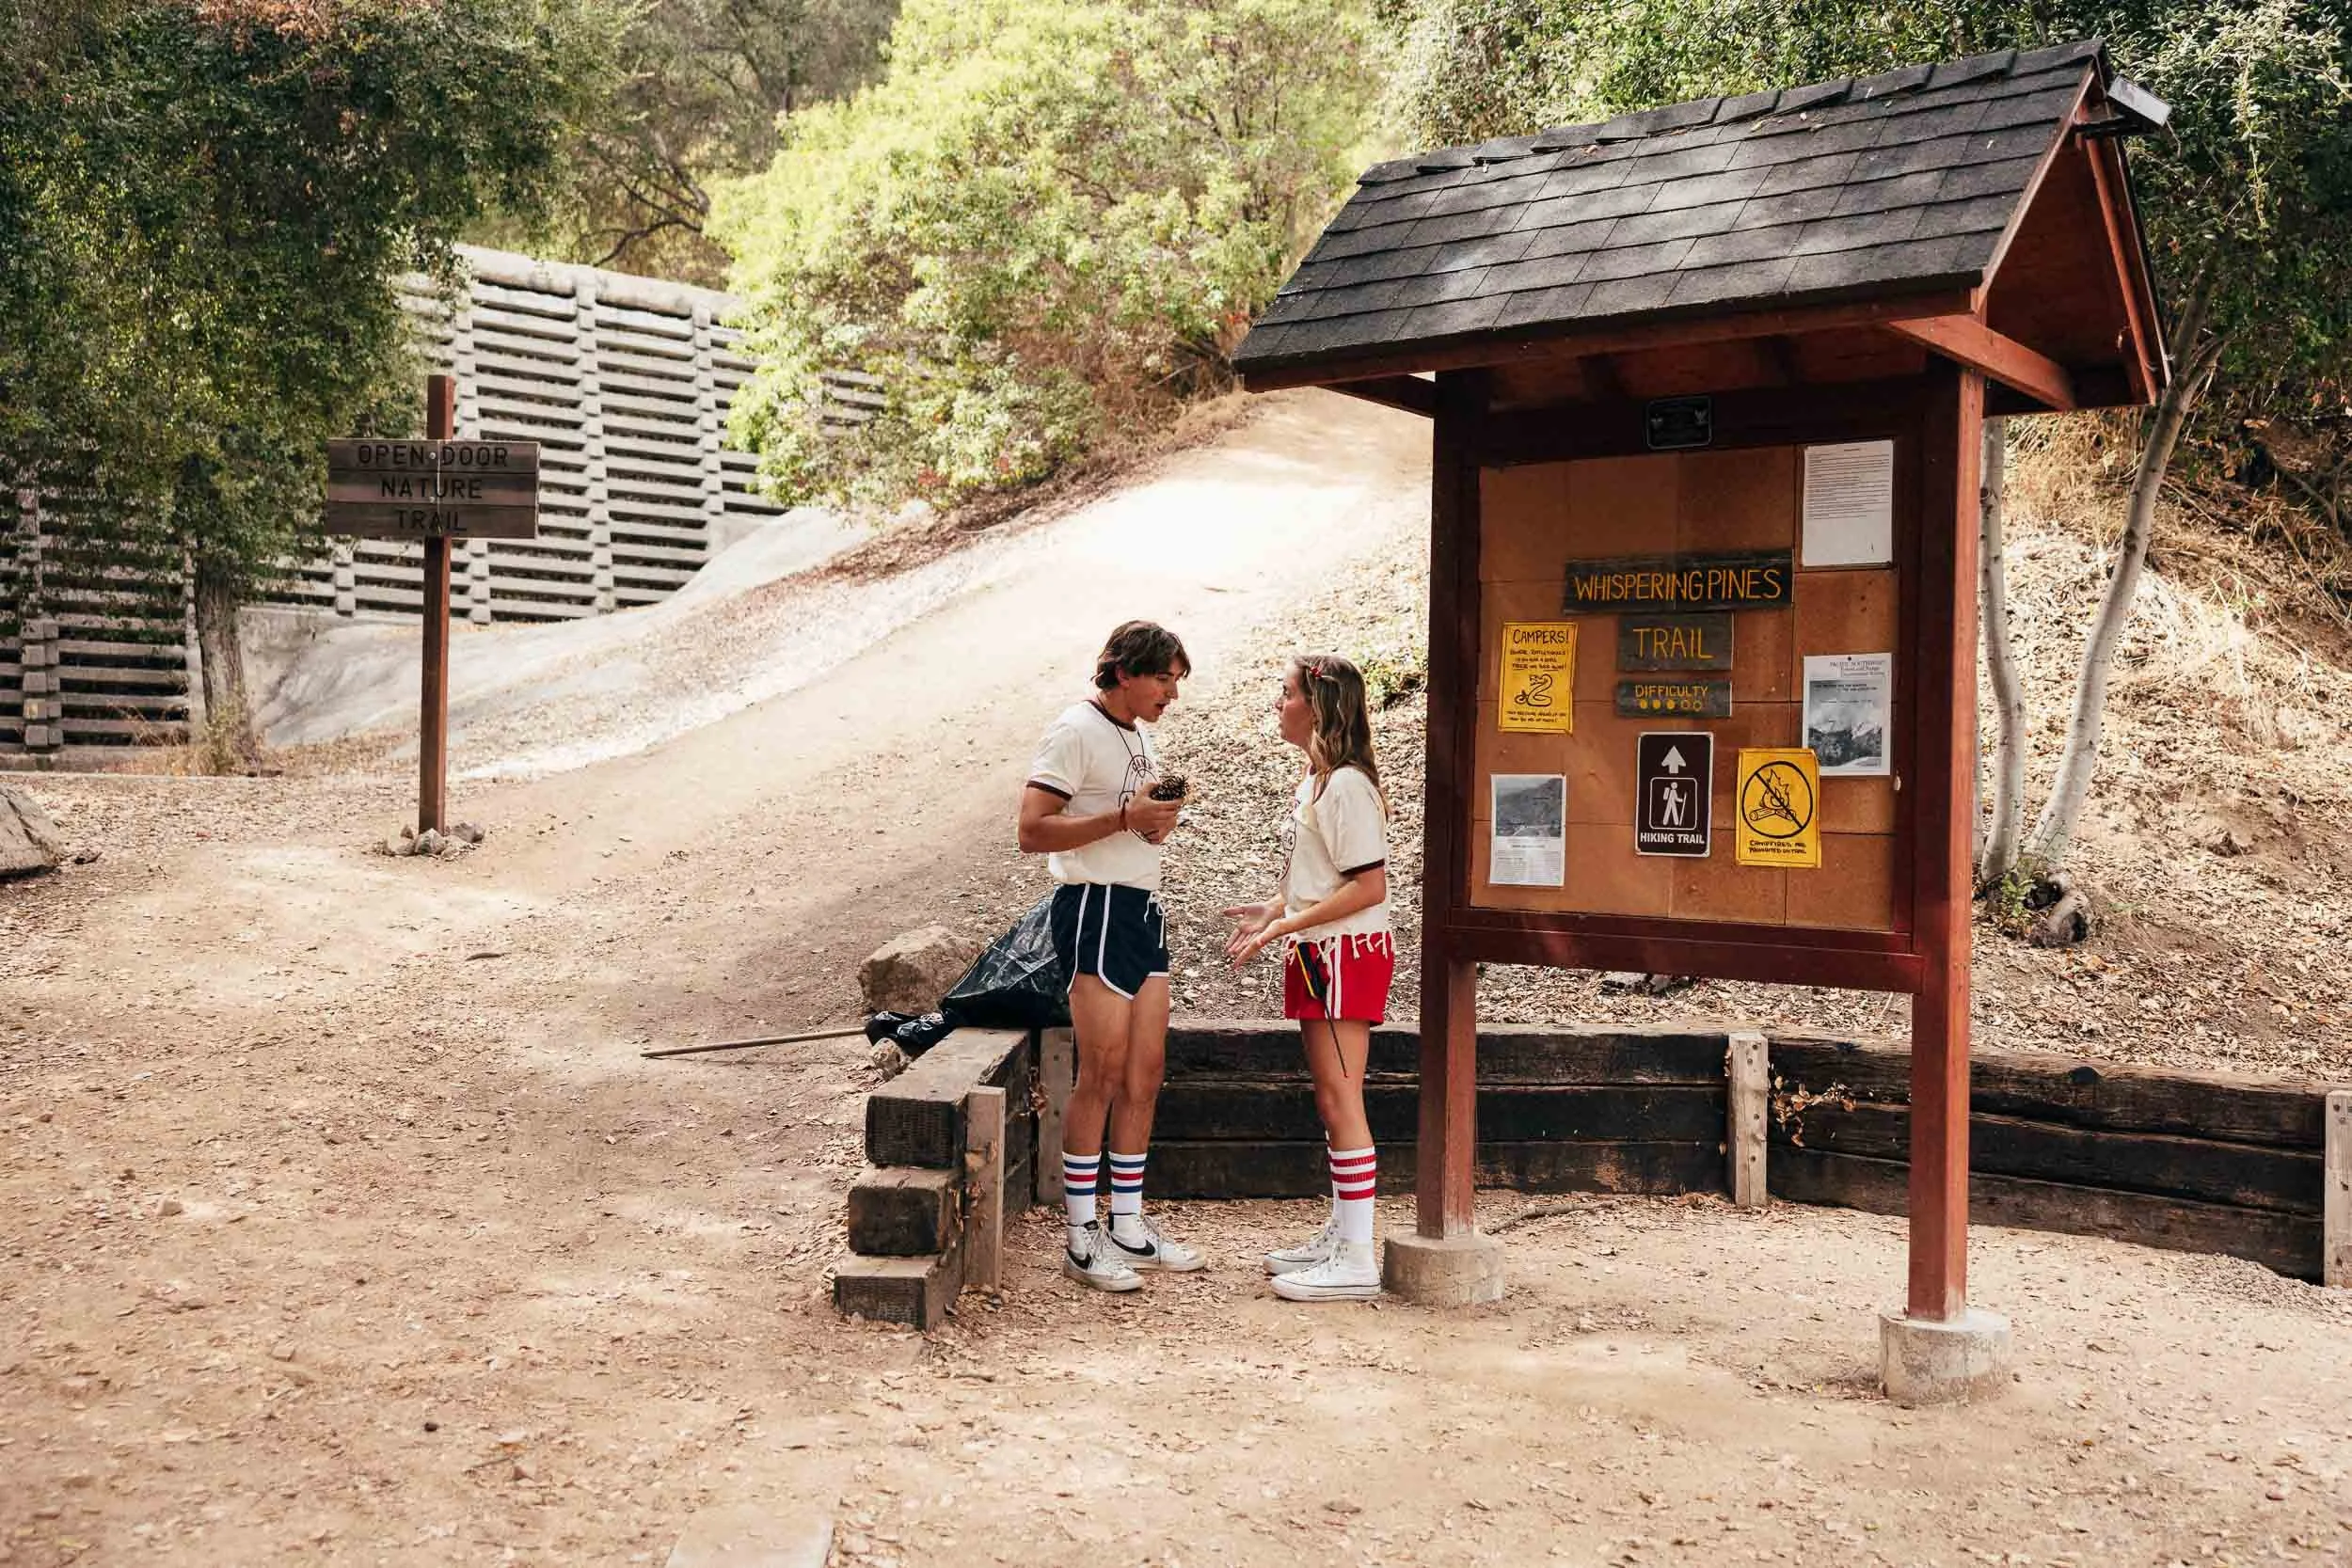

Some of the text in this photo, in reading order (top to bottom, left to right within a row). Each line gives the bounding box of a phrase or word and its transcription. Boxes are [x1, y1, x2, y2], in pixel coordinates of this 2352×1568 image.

[358, 445, 507, 467] OPEN DOOR
[381, 478, 482, 499] NATURE
[395, 509, 467, 531] TRAIL
[1575, 569, 1781, 602] WHISPERING PINES
[1513, 628, 1568, 644] CAMPERS!
[1632, 626, 1715, 659] TRAIL
[1635, 684, 1708, 697] DIFFICULTY
[1640, 832, 1705, 844] HIKING TRAIL
